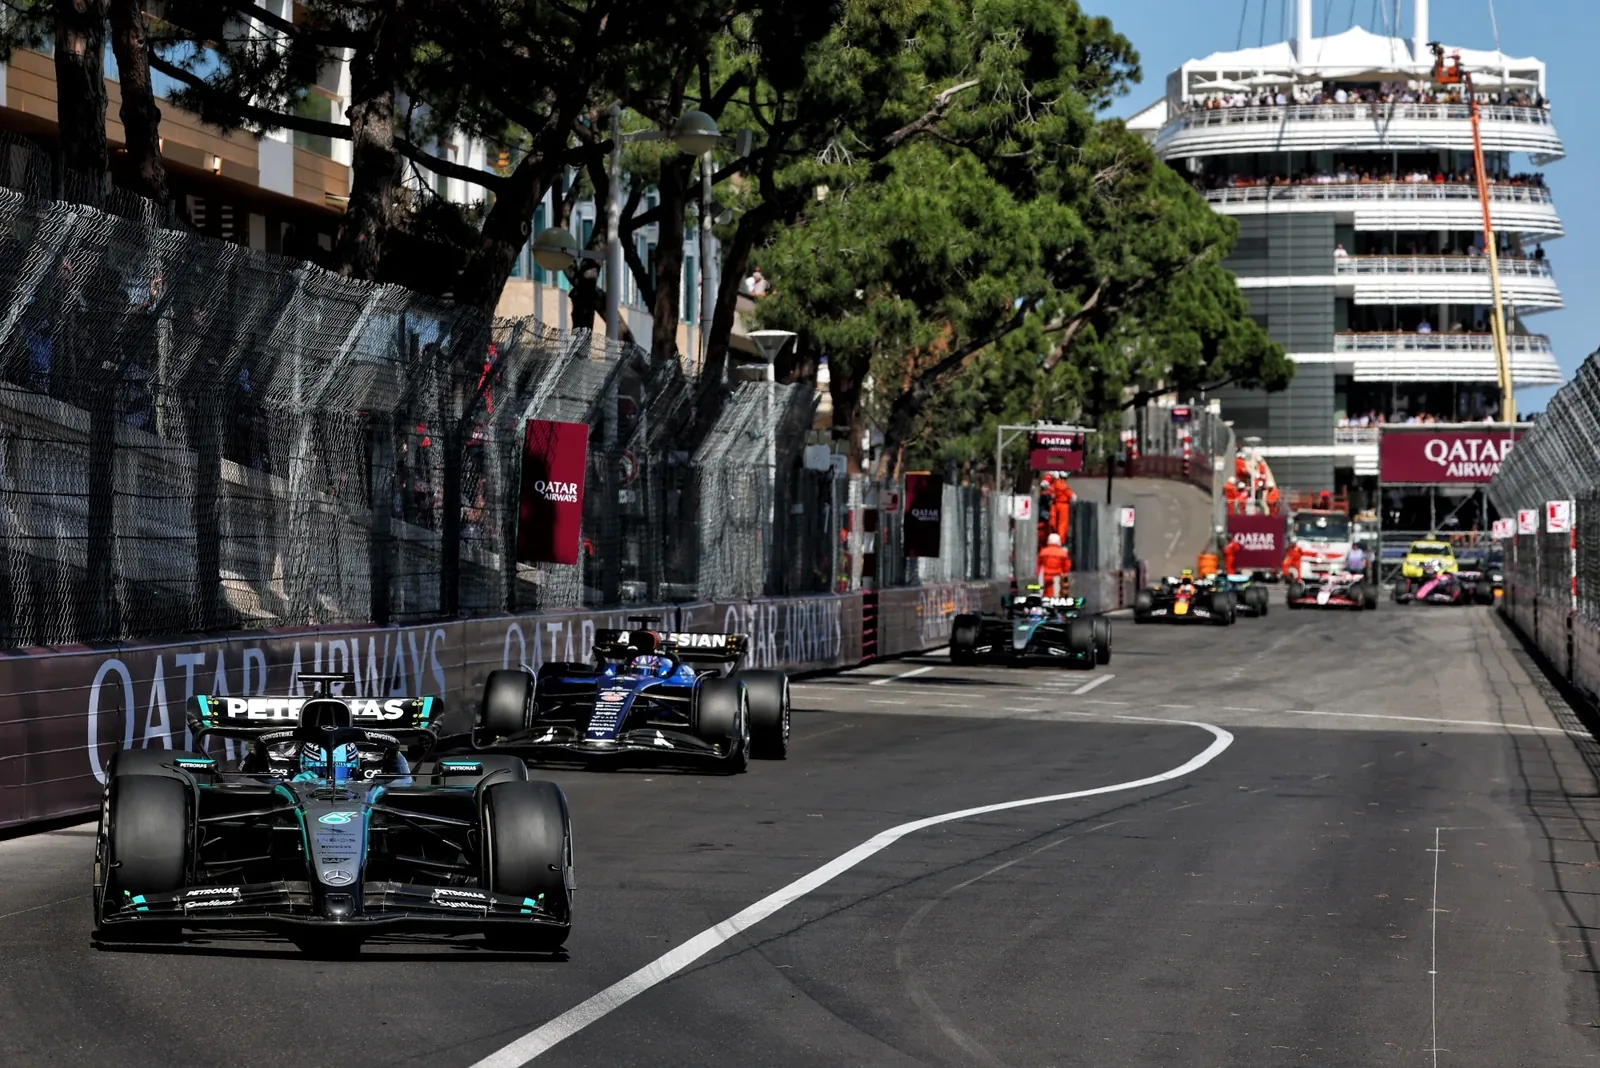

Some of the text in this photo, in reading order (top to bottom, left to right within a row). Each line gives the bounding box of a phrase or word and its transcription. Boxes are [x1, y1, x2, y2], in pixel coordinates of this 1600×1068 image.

[1041, 437, 1072, 446] QATAR
[1424, 438, 1514, 466] QATAR
[1446, 462, 1503, 477] AIRWA
[534, 480, 578, 495] QATAR
[544, 493, 578, 503] AIRWAYS
[911, 508, 939, 518] QATAR
[1234, 533, 1274, 544] QATAR
[617, 631, 727, 648] ASIAN
[227, 698, 404, 721] PETRAS
[87, 648, 268, 785] QATAR
[186, 887, 240, 897] PETRONAS
[434, 888, 487, 899] PETRONAS
